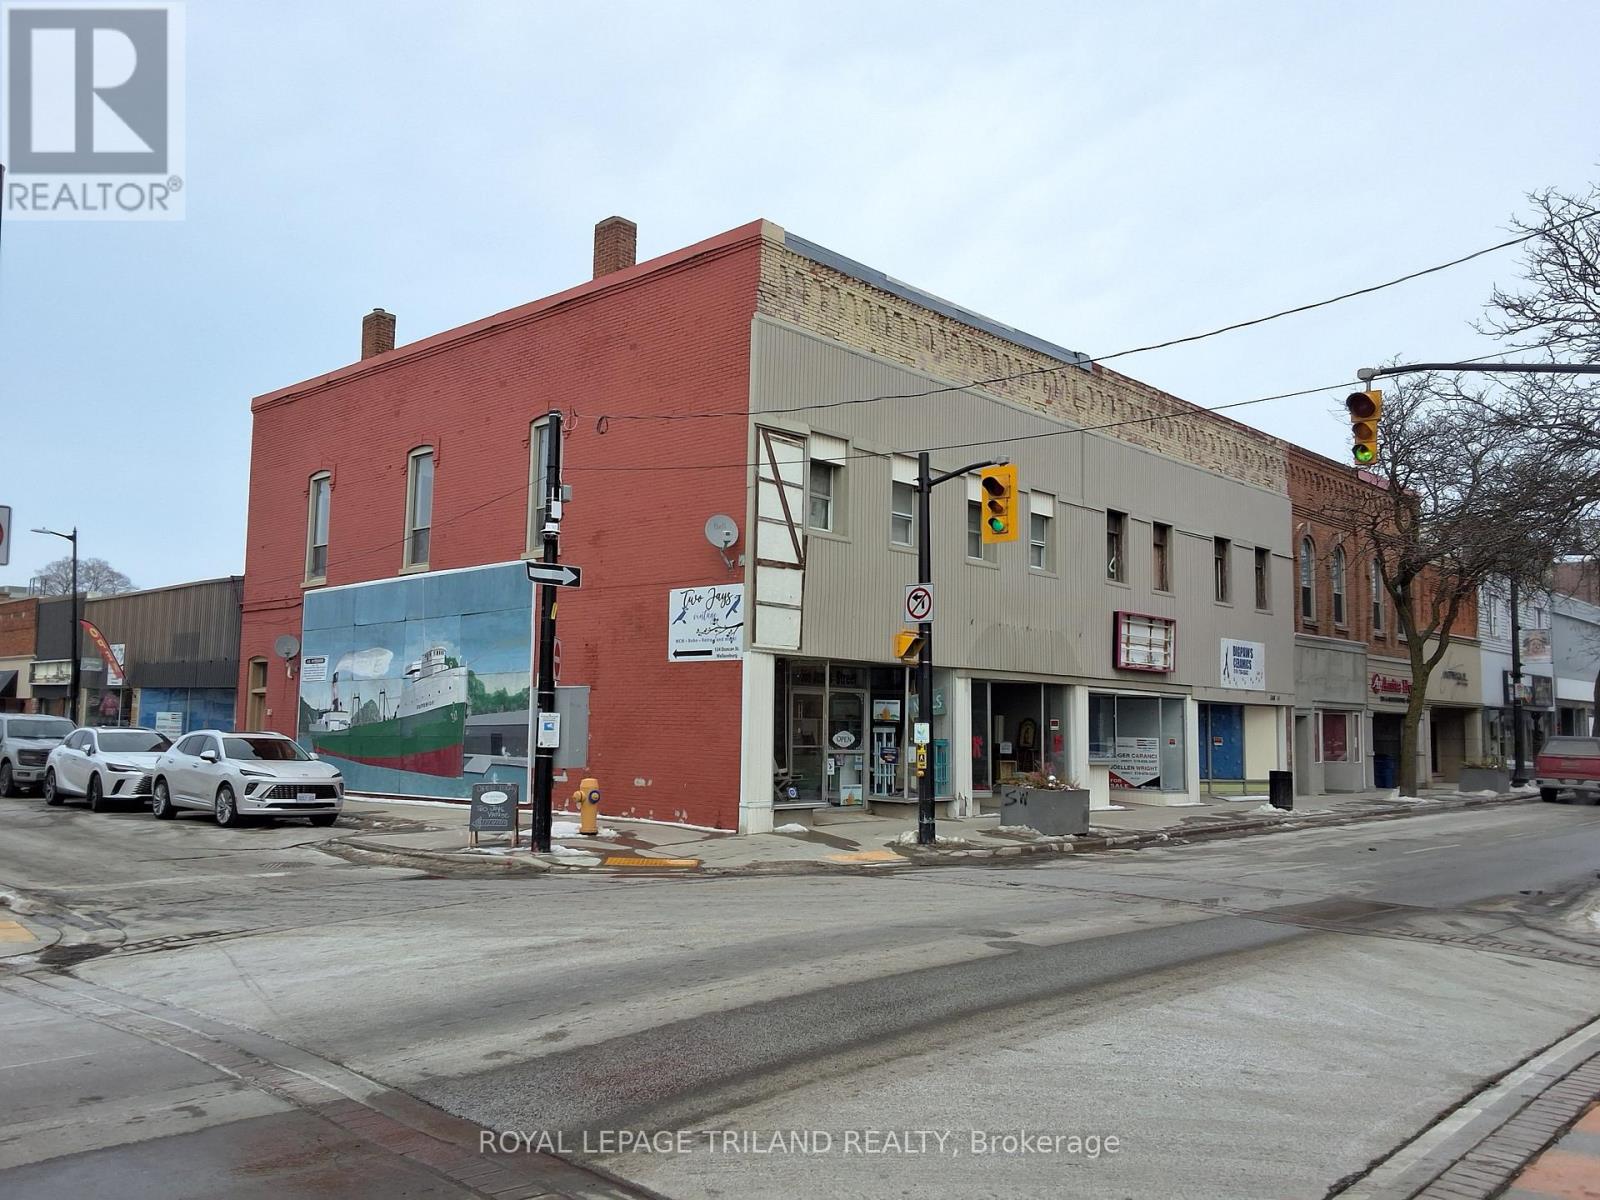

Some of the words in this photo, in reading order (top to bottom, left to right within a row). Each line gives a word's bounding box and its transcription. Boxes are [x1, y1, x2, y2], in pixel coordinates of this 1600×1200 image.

[680, 589, 704, 608] Two
[706, 587, 732, 610] Jays
[836, 734, 852, 743] OPEN
